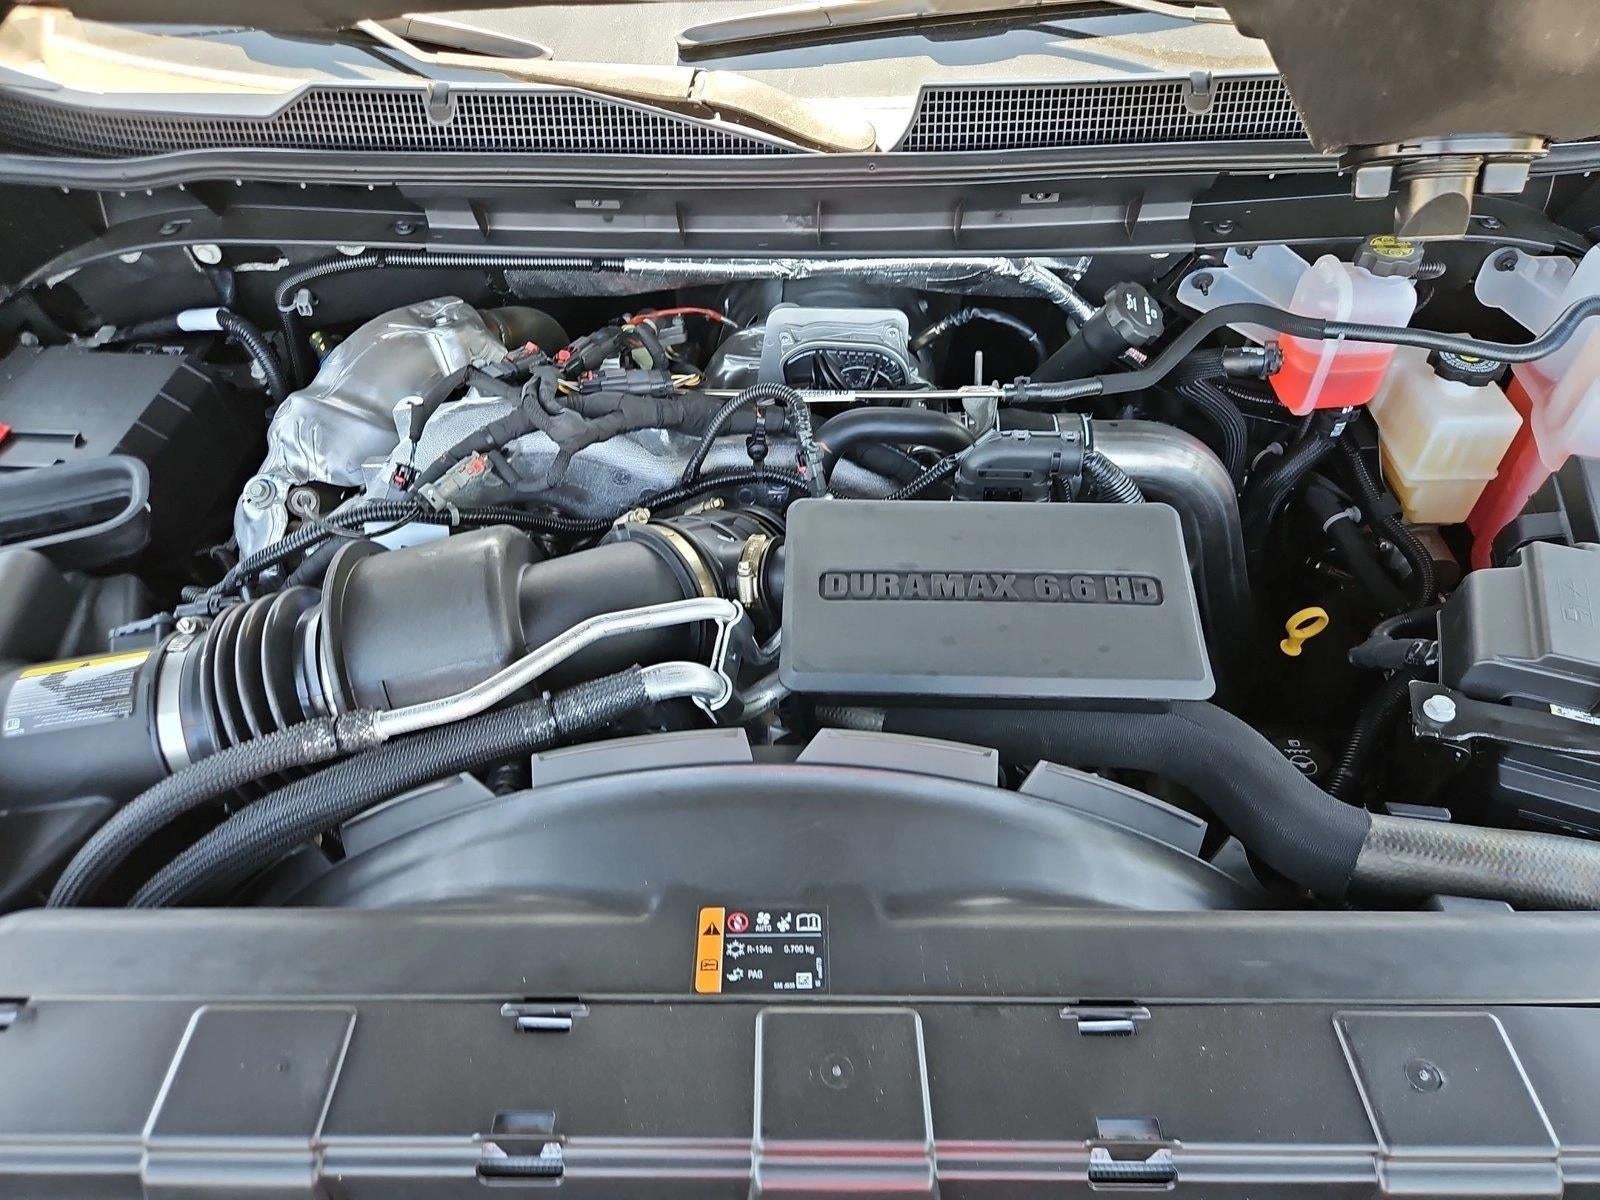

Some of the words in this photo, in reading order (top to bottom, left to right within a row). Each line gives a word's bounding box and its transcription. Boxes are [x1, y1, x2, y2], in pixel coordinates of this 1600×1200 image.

[823, 572, 1020, 600] DURAMAX
[1033, 574, 1096, 601] 6.6
[1104, 576, 1159, 602] HD
[755, 924, 772, 933] AUTO
[746, 944, 773, 954] R-134a
[783, 944, 804, 954] 0.700
[804, 944, 815, 955] kg
[747, 969, 763, 980] PAG
